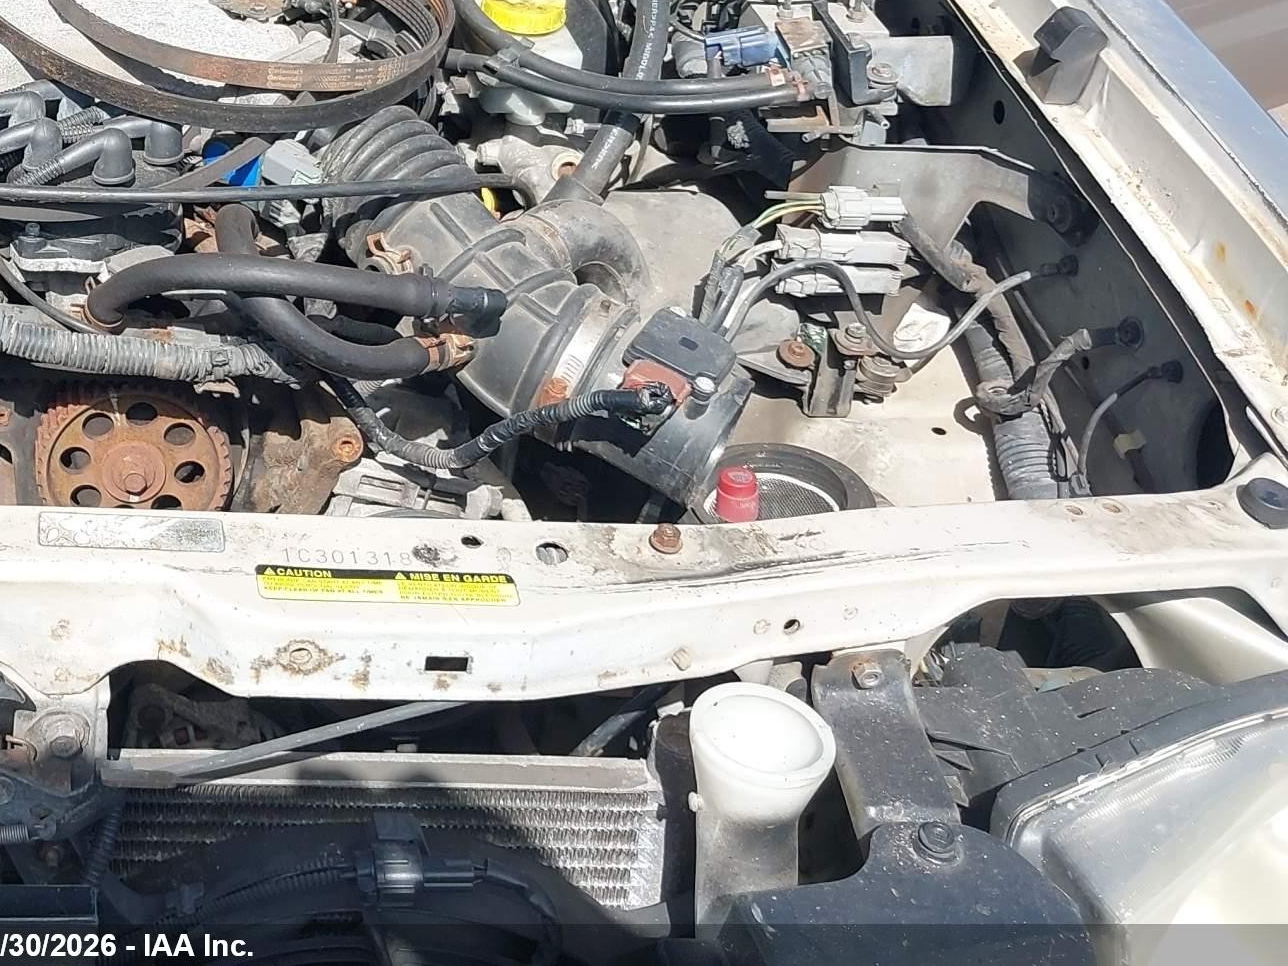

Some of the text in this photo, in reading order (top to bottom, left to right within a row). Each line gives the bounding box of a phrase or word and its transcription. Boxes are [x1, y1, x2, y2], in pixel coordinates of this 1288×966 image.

[276, 567, 333, 579] CAUTION
[409, 572, 508, 584] MISE EN GARDE
